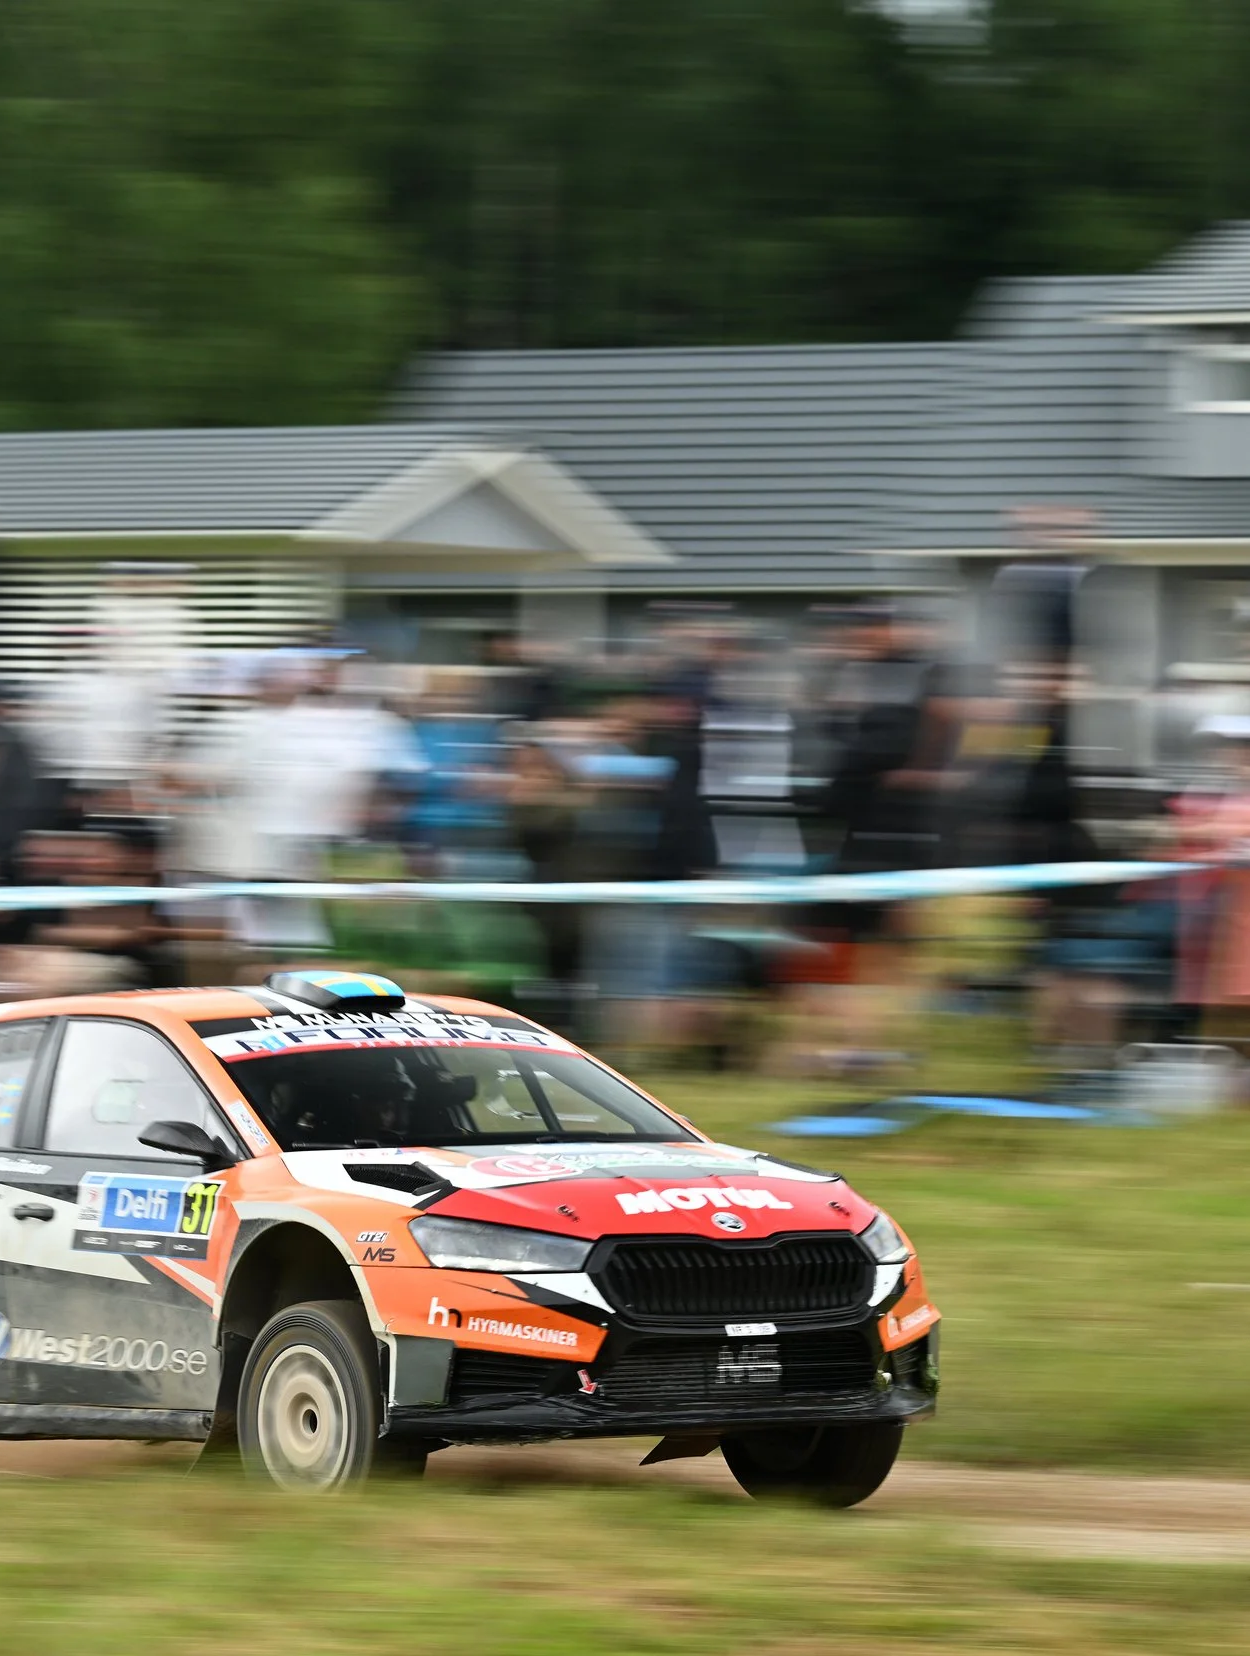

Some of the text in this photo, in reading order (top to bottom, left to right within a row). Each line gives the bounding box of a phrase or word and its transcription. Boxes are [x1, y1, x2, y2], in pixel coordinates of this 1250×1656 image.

[114, 1188, 168, 1220] Delfi
[182, 1182, 218, 1234] 31
[615, 1187, 793, 1215] MOTUL
[363, 1247, 396, 1262] MS
[468, 1317, 578, 1347] HYRMASKINER
[10, 1327, 207, 1375] West2000.se
